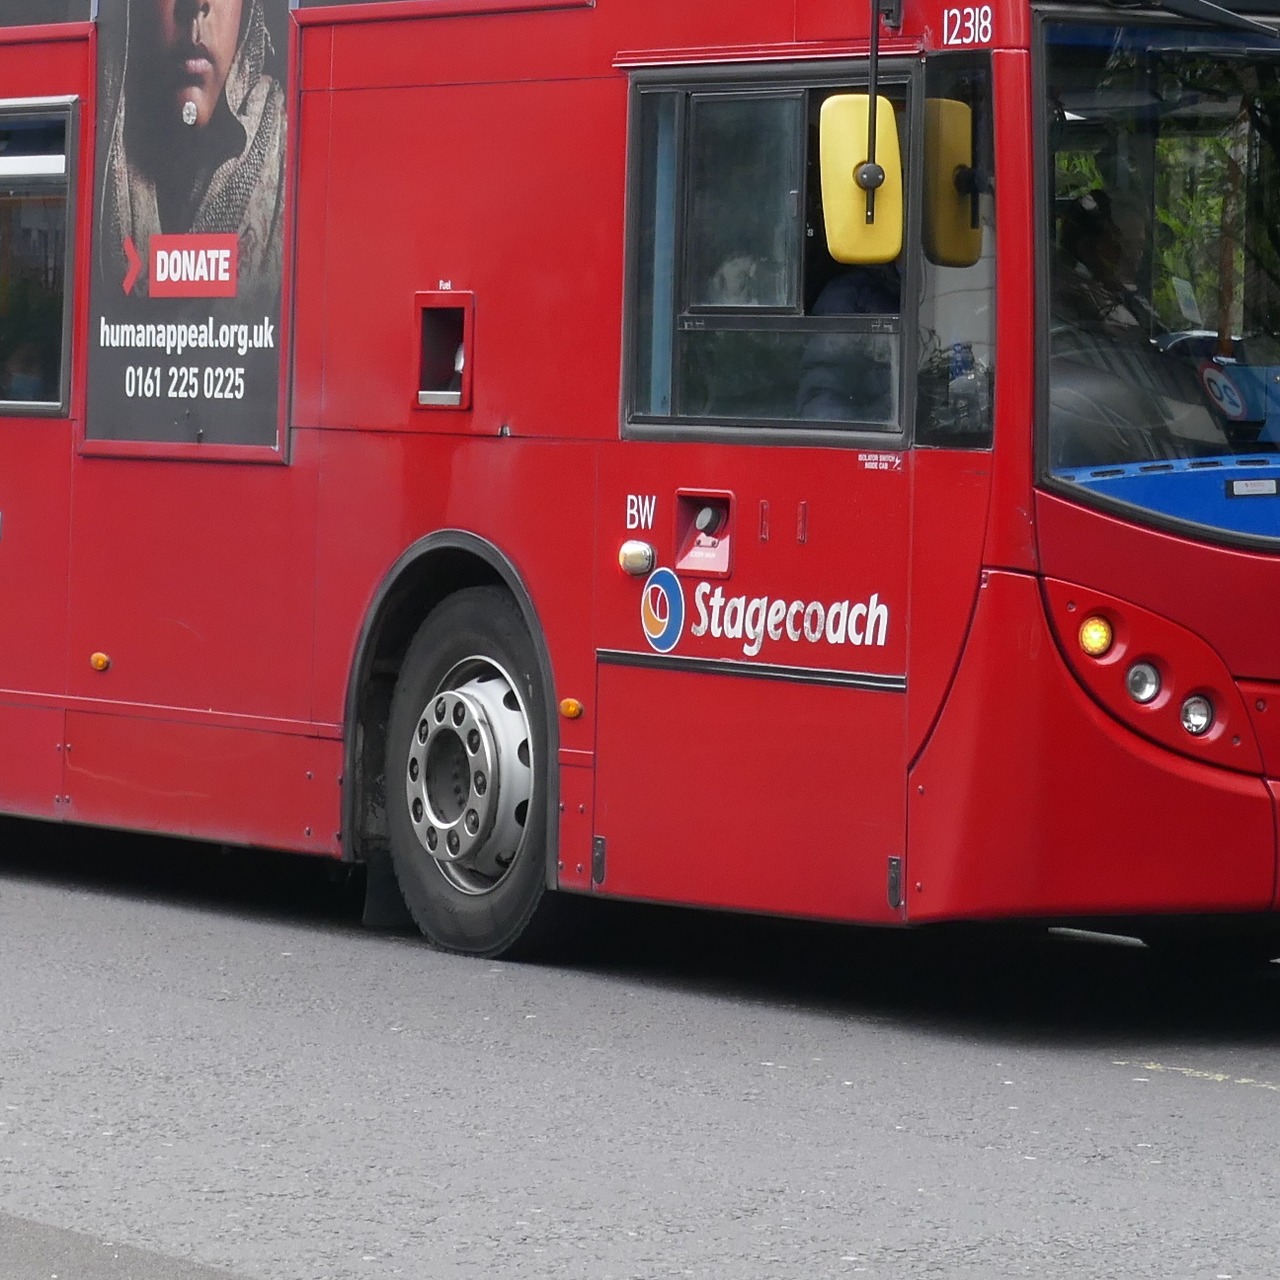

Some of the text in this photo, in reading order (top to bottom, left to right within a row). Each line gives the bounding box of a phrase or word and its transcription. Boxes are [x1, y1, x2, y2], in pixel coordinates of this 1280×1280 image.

[943, 5, 992, 46] 12318
[156, 249, 231, 282] DONATE
[99, 316, 275, 356] humanappeal.org.uk
[125, 365, 245, 400] 0161 225 0225
[626, 494, 657, 530] BW
[690, 581, 889, 657] Stagecoach
